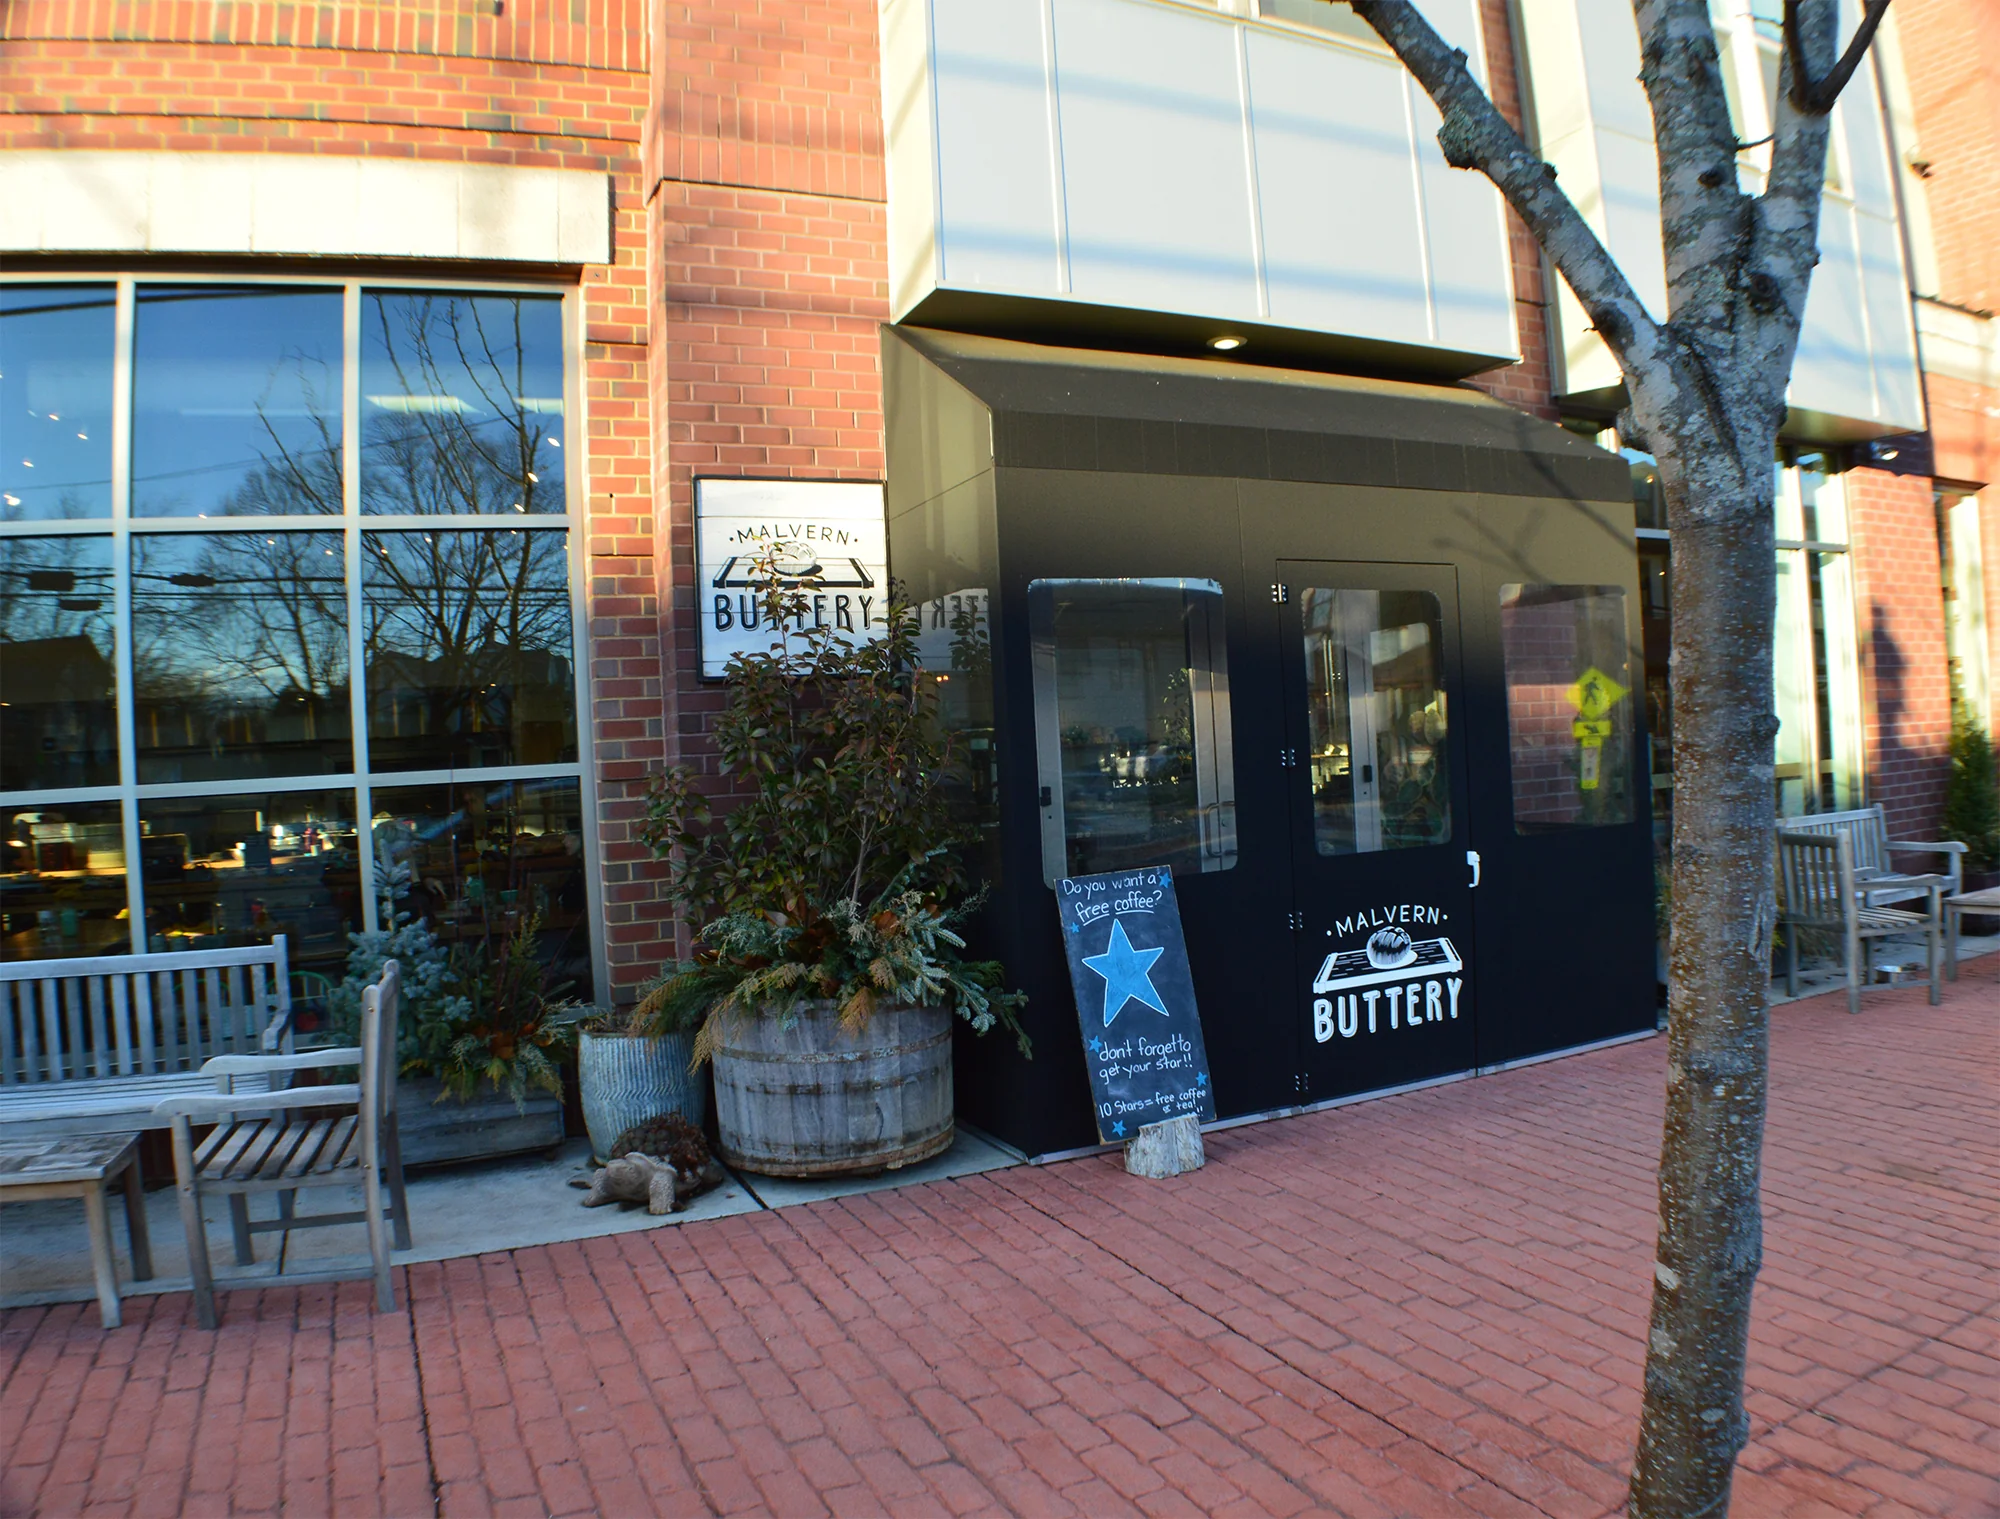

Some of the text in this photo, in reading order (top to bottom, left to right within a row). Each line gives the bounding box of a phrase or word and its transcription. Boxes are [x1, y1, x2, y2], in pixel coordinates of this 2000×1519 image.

[737, 524, 849, 545] MALVERN
[714, 594, 874, 632] BUTERY
[1063, 873, 1156, 900] Do you want a
[1075, 889, 1162, 923] free coffee?
[1335, 904, 1440, 938] MALVERN
[1313, 977, 1463, 1043] BUTTERY
[1099, 1033, 1192, 1062] don't forget to
[1099, 1062, 1121, 1085] get
[1122, 1062, 1151, 1079] your
[1099, 1103, 1113, 1118] 10
[1154, 1091, 1175, 1105] free
[1178, 1087, 1206, 1101] coffee
